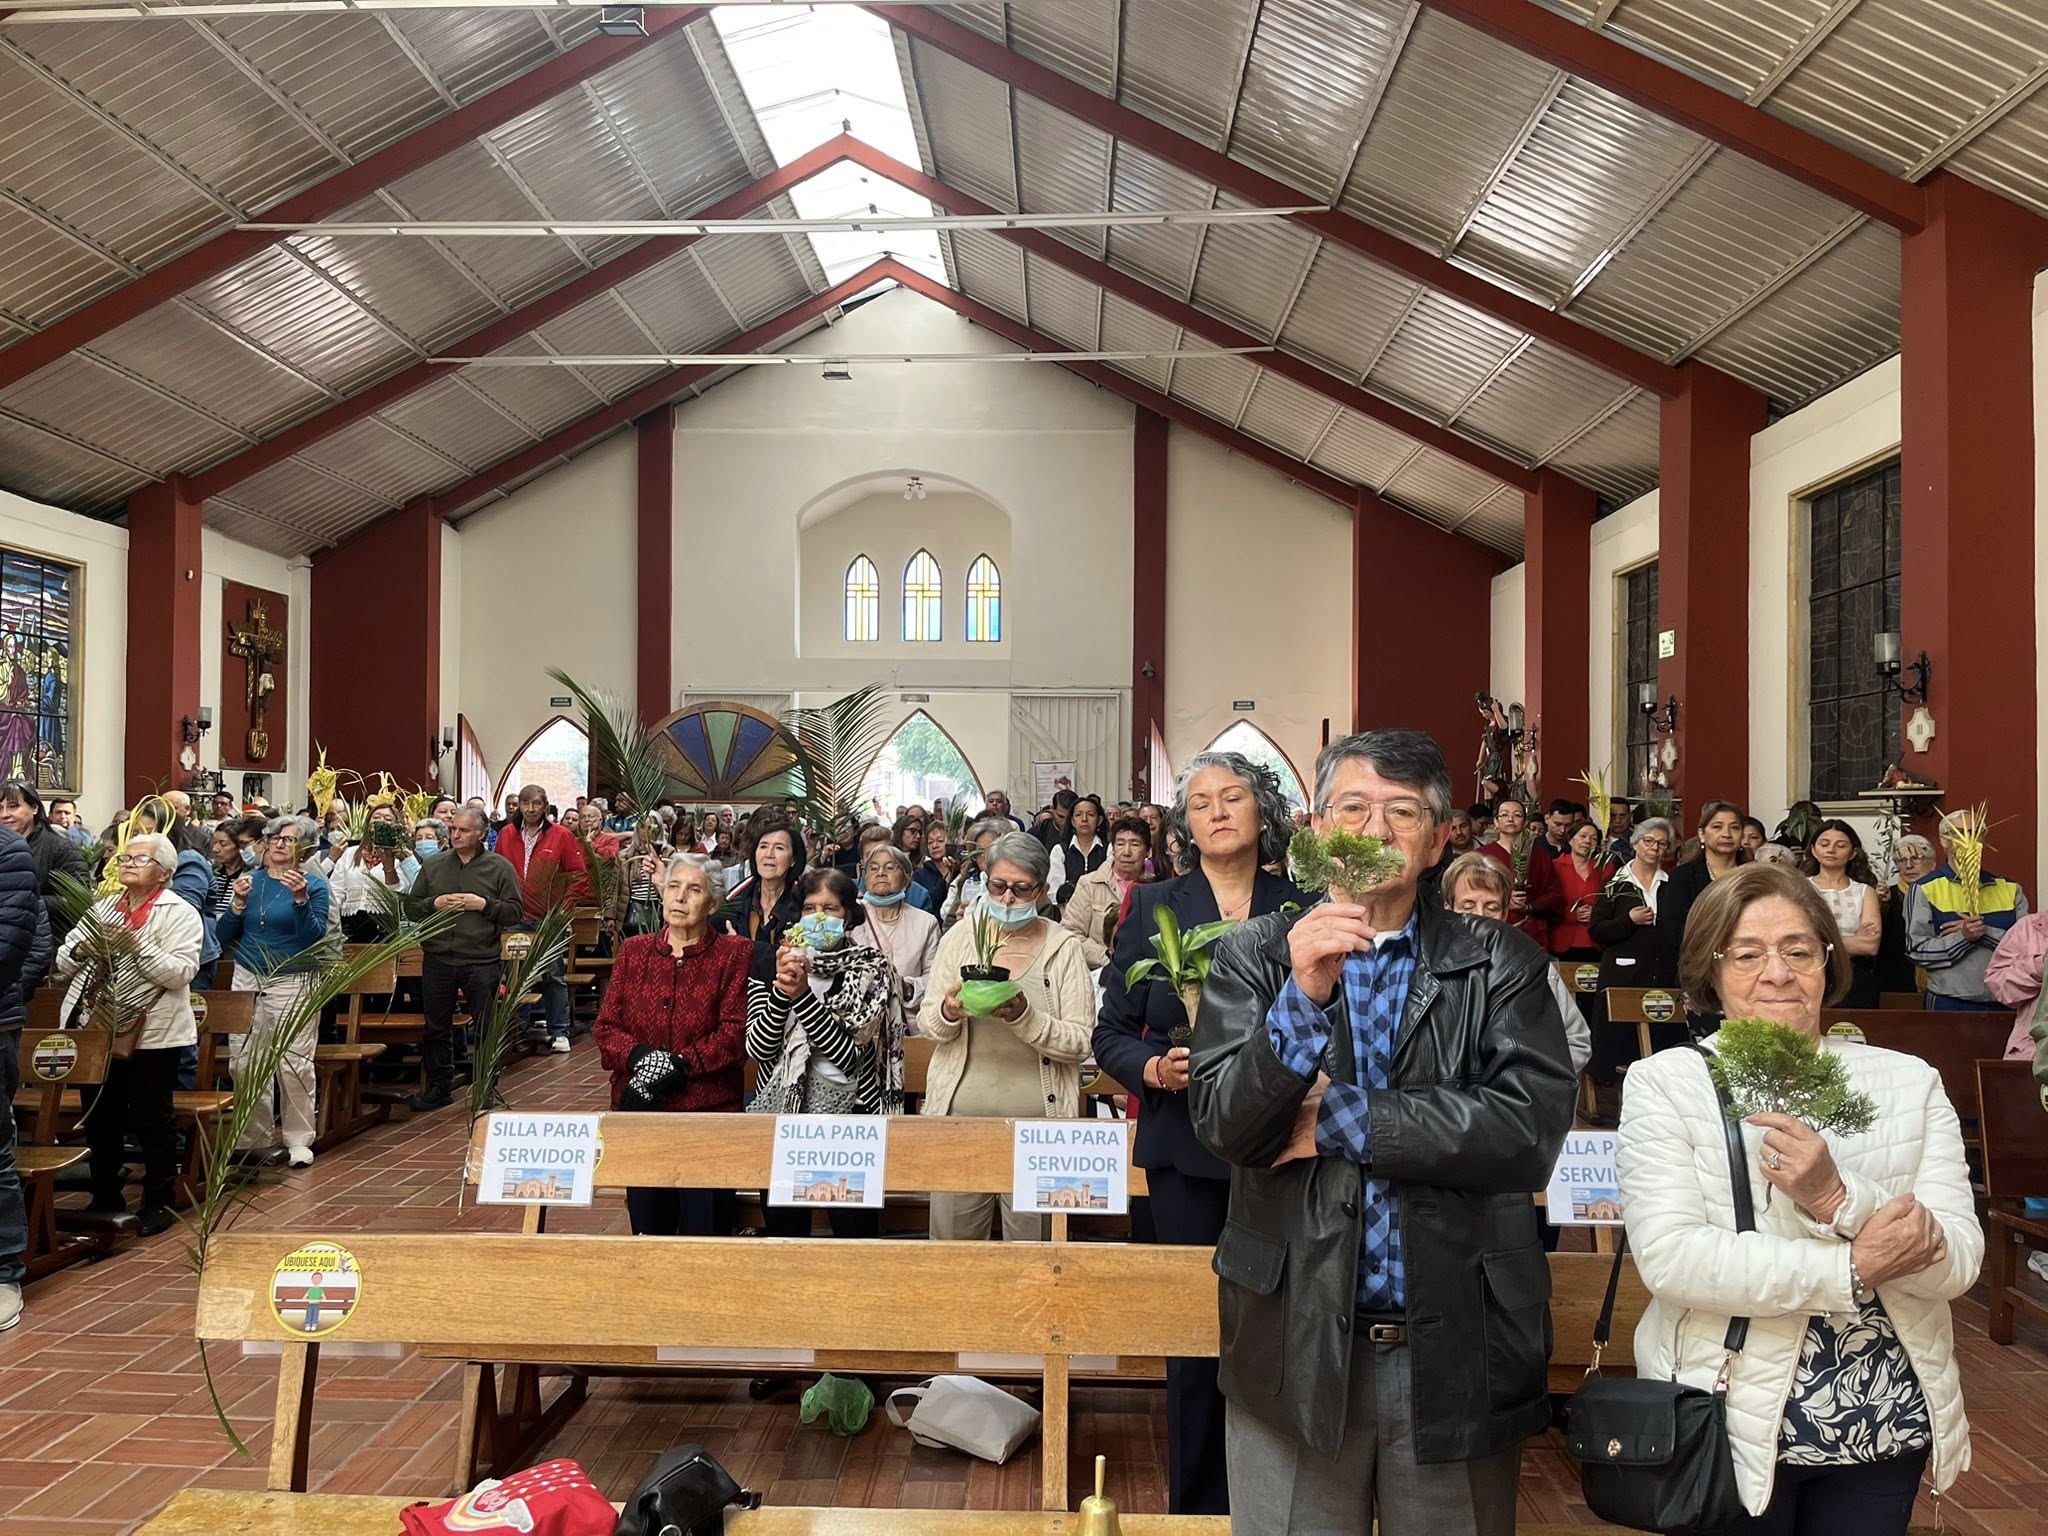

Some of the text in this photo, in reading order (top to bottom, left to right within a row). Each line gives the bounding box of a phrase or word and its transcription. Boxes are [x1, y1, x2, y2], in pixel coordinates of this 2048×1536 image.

[493, 1121, 590, 1138] SILLA PARA
[780, 1124, 879, 1140] SILLA PARA
[1019, 1129, 1120, 1145] SILLA PARA
[1561, 1140, 1597, 1155] LLA
[497, 1148, 586, 1164] SERVIDOR
[786, 1150, 875, 1166] SERVIDOR
[1027, 1155, 1118, 1172] SERVIDOR
[1560, 1167, 1617, 1182] SERVI
[284, 1256, 317, 1267] UBIQUESE
